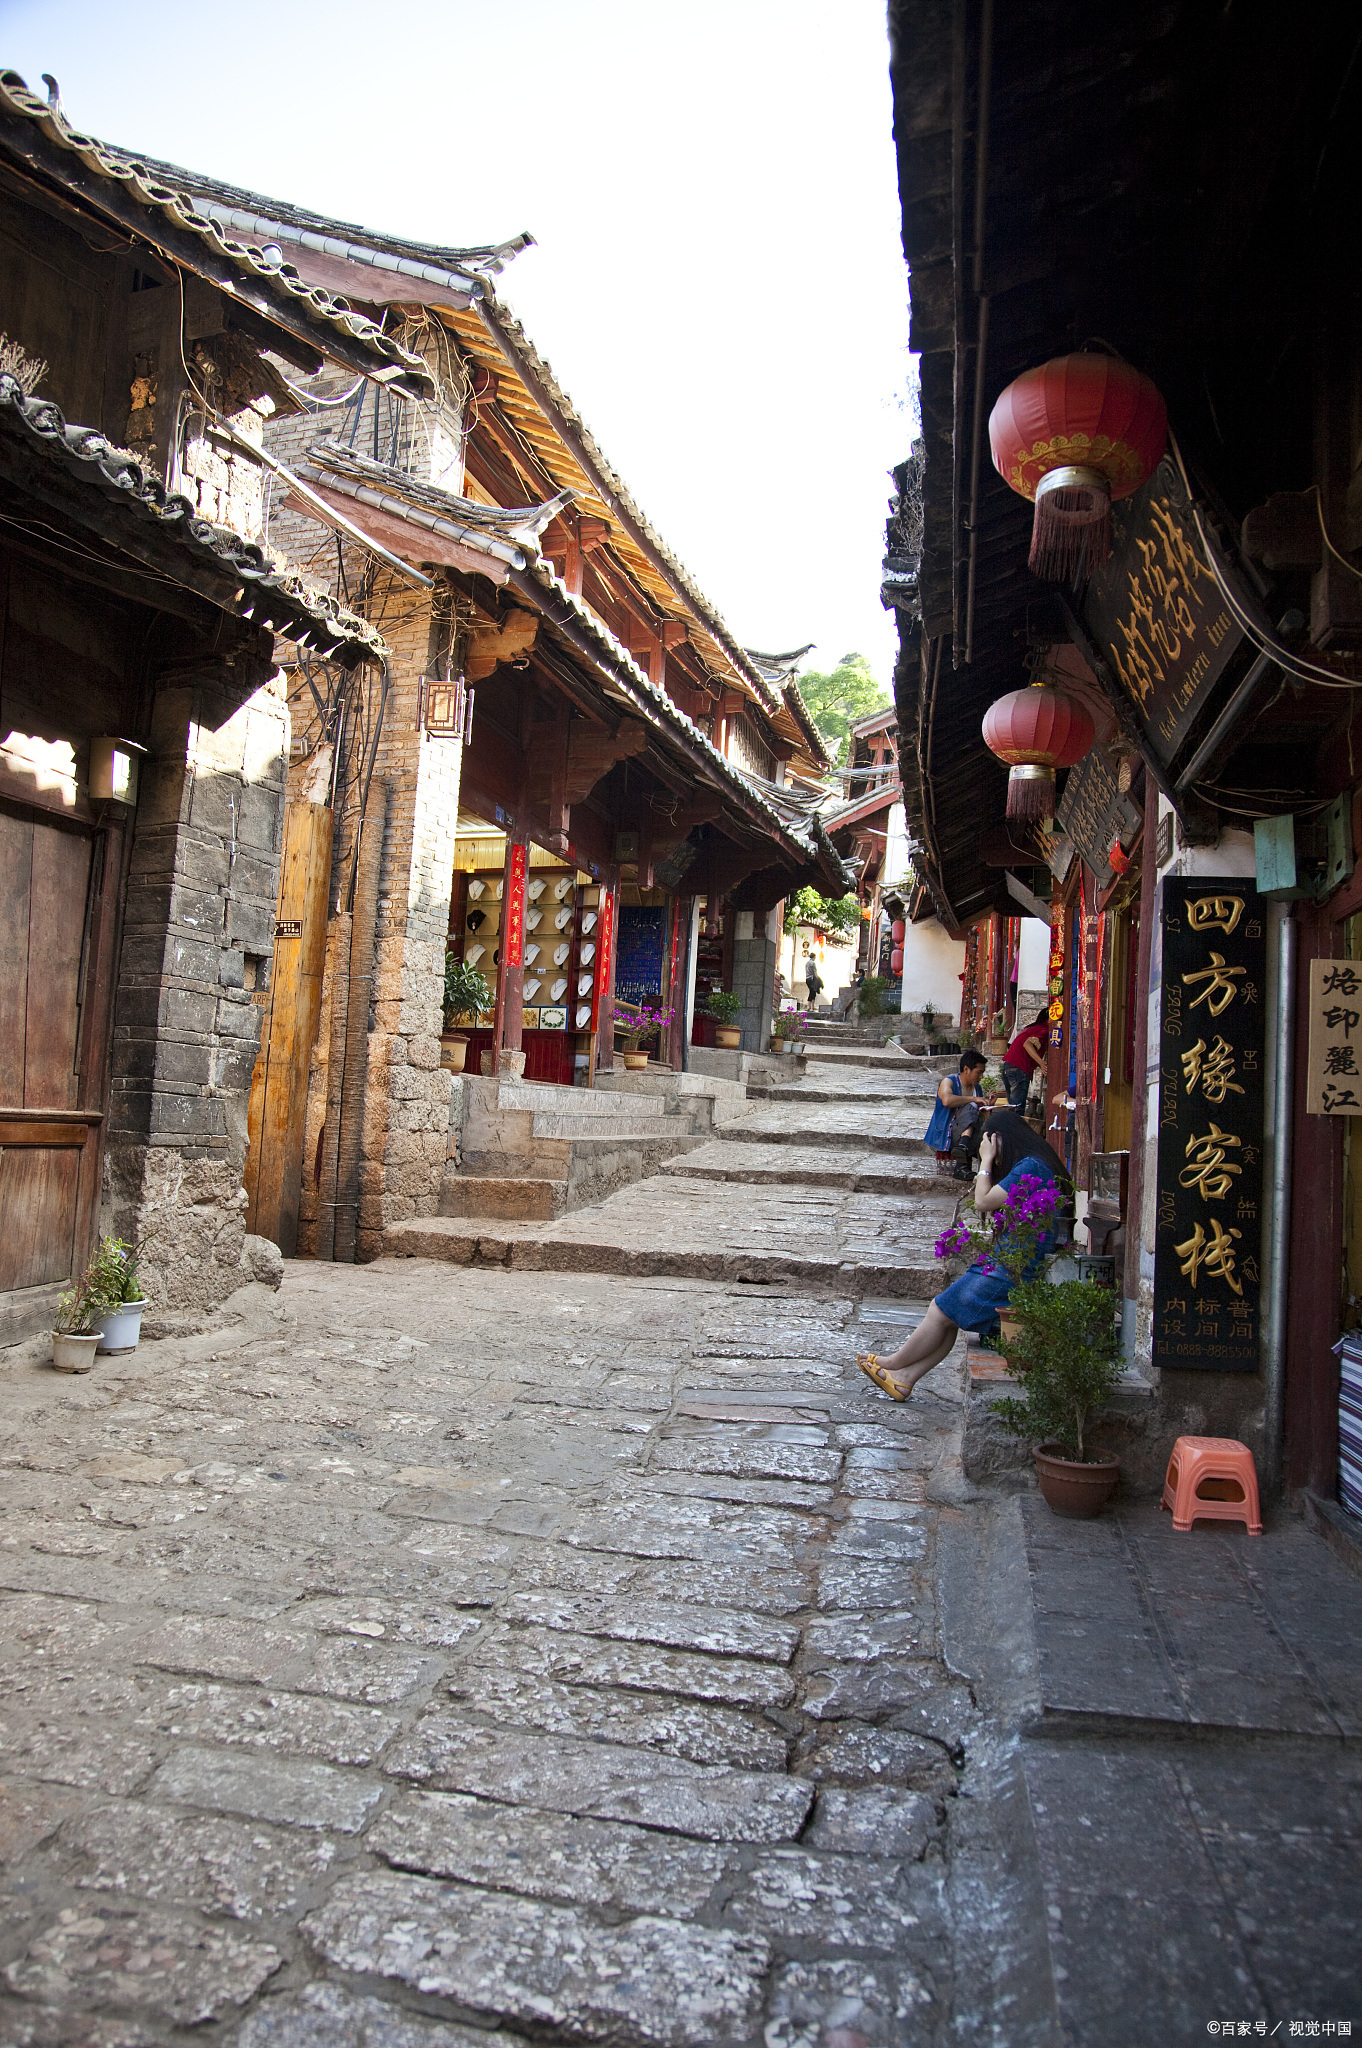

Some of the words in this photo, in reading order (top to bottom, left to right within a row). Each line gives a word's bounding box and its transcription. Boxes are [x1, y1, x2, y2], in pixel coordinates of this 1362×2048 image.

[1159, 706, 1178, 742] Red
[1172, 650, 1211, 712] Lantern
[1203, 611, 1232, 649] Inn
[1166, 914, 1181, 934] SI
[1049, 953, 1063, 1045] 益智玩具
[1163, 984, 1183, 1036] FANG
[1160, 1067, 1179, 1129] YUAN
[1158, 1189, 1177, 1231] INN
